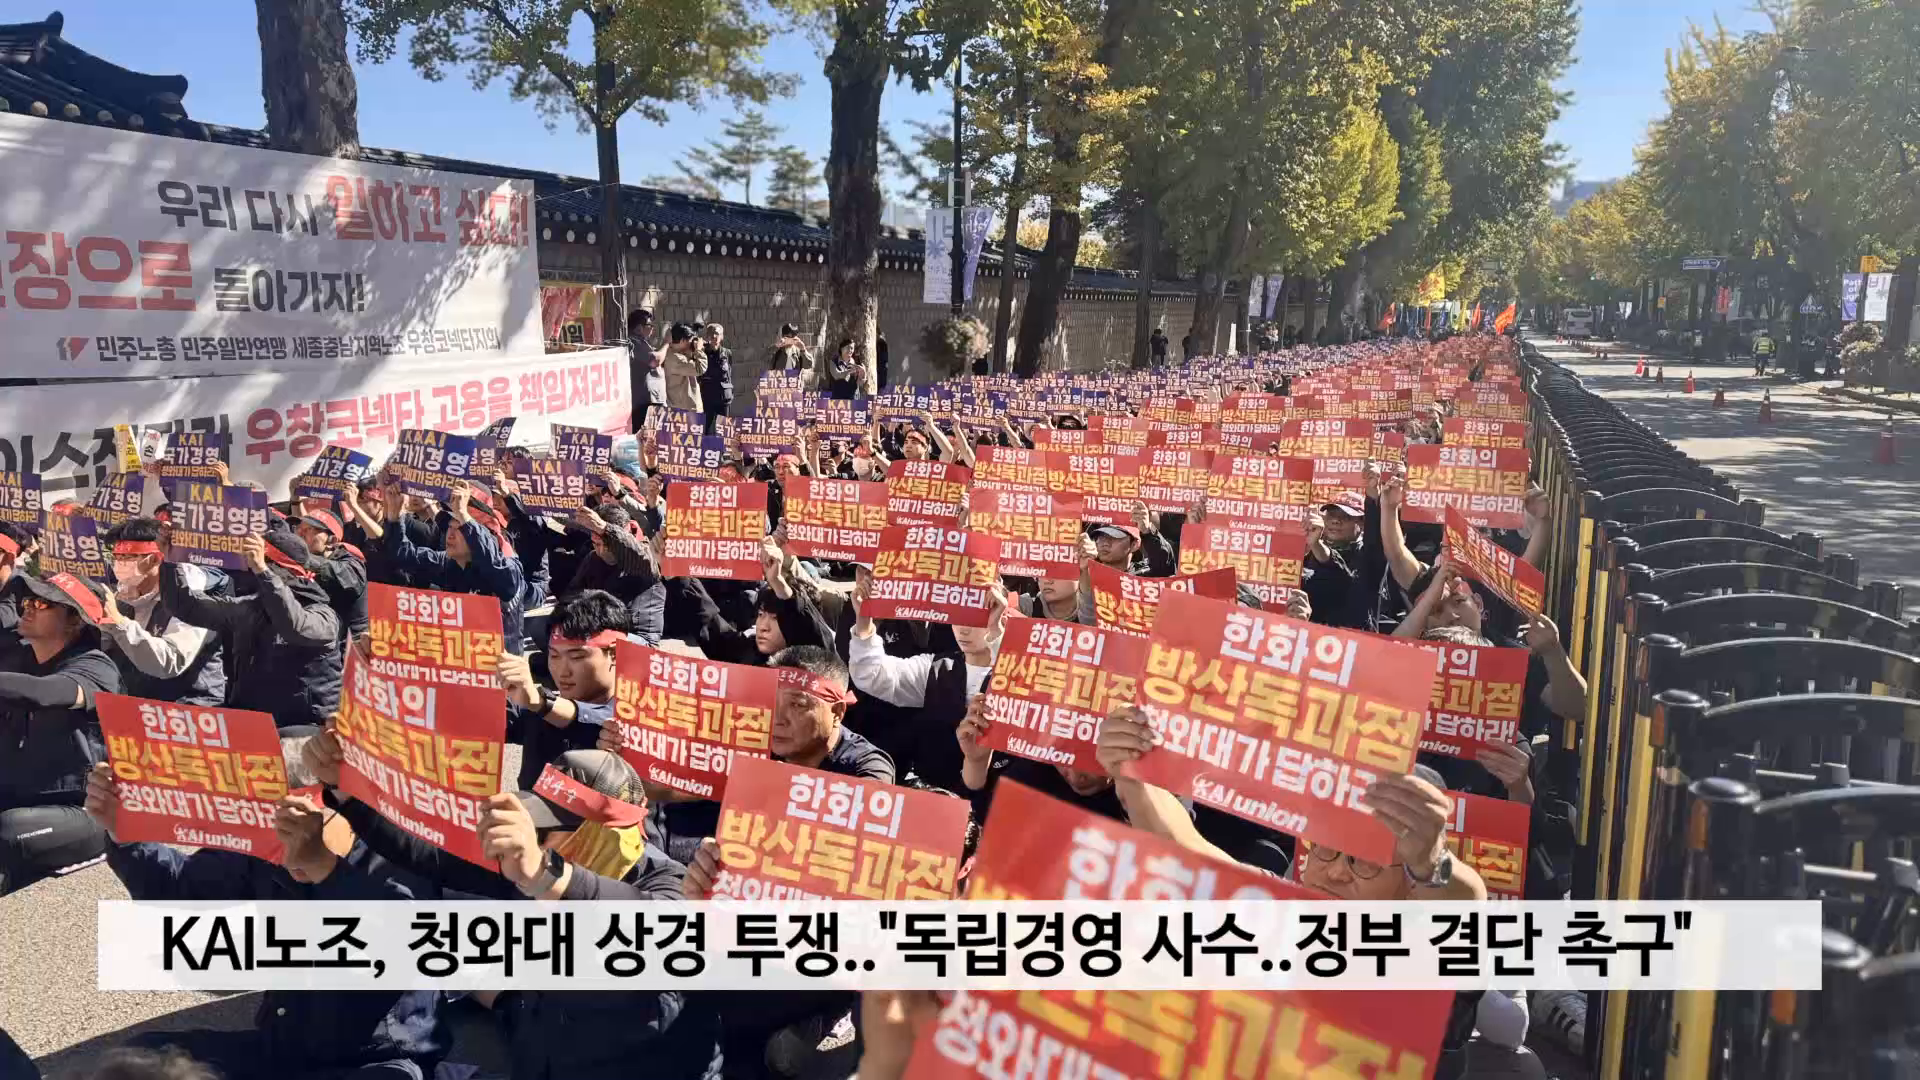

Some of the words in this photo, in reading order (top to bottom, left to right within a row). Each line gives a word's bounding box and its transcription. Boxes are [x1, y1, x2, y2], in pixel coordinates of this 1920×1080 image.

[157, 181, 237, 232] 우리
[245, 190, 318, 236] 다시
[327, 176, 446, 244] 일하고
[0, 231, 196, 311] 장으로
[214, 267, 364, 313] 돌아가자!
[96, 336, 176, 362] 민주노총
[180, 336, 288, 361] 민주일반연맹
[432, 377, 512, 433] 고용을
[519, 361, 619, 416] 책임져라!
[895, 384, 916, 394] KAI
[1370, 389, 1398, 402] 한화의
[1475, 393, 1510, 404] 한화의
[755, 407, 780, 418] KAI
[828, 399, 851, 410] KAI
[880, 394, 928, 409] 국가경영
[1149, 397, 1177, 409] 한화의
[1237, 398, 1269, 410] 한화의
[1357, 399, 1413, 413] 방산독과점
[741, 417, 796, 435] 국가경영
[816, 409, 866, 425] 국가경영
[1102, 416, 1132, 430] 한화의
[1220, 409, 1283, 424] 방산독과점
[1299, 420, 1347, 437] 한화의
[1463, 420, 1504, 437] 한화의
[179, 433, 205, 446] KAI
[572, 434, 595, 446] KAI
[671, 432, 703, 447] KAI
[1050, 430, 1085, 444] 한화의
[1165, 429, 1202, 445] 한화의
[1278, 437, 1371, 458] 방산독과점
[164, 447, 219, 467] 국가경영
[558, 443, 610, 465] 국가경영
[657, 443, 720, 468] 국가경영
[992, 448, 1031, 466] 한화의
[1069, 455, 1114, 475] 한화의
[1152, 449, 1192, 467] 한화의
[1439, 446, 1498, 469] 한화의
[532, 460, 561, 474] KAI
[904, 461, 948, 481] 한화의
[974, 460, 1048, 487] 방산독과점
[1231, 457, 1285, 479] 한화의
[516, 474, 584, 497] 국가경영
[809, 480, 860, 504] 한화의
[1048, 468, 1140, 498] 방산독과점
[1207, 474, 1312, 506] 방산독과점
[1407, 464, 1527, 497] 방산독과점
[191, 483, 223, 504] KAI
[690, 485, 737, 508] 한화의
[998, 493, 1053, 516] 한화의
[1405, 490, 1468, 511] 청와대가
[786, 496, 888, 530] 방산독과점
[888, 498, 921, 515] 와대가
[1205, 498, 1259, 519] 청와대가
[667, 507, 765, 540] 방산독과점
[786, 523, 838, 546] 청와대가
[970, 510, 1080, 546] 방산독과점
[664, 539, 716, 561] 청와대가
[904, 526, 968, 554] 한화의
[1210, 528, 1273, 555] 한화의
[871, 549, 1000, 588] 방산독과점
[869, 579, 930, 602] 청와대가
[396, 590, 463, 627] 한화의
[370, 615, 503, 671] 방산독과점
[1026, 622, 1106, 666] 한화의
[1219, 610, 1359, 689] 한화의
[649, 652, 729, 699] 한화의
[990, 652, 1137, 714] 방산독과점
[354, 660, 437, 731] 한화의
[614, 675, 773, 750] 방산독과점
[982, 693, 1050, 733] 청와대가
[1142, 641, 1423, 776] 방산독과점
[138, 702, 231, 749] 한화의
[1435, 712, 1516, 745] 답하라!
[335, 688, 501, 797] 방산독과점
[617, 720, 688, 767] 청와대가
[1006, 732, 1028, 755] KAI
[1026, 744, 1076, 767] union
[1138, 703, 1272, 781] 청와대가
[107, 733, 289, 801] 방산독과점
[337, 734, 411, 806] 청와대가
[648, 763, 672, 786] KAI
[671, 776, 714, 798] union
[116, 781, 216, 822] 청와대가
[786, 772, 905, 840] 한화의
[1190, 769, 1236, 811] KAI
[1233, 790, 1309, 834] union
[376, 794, 402, 826] KAI
[400, 814, 445, 847] union
[173, 823, 204, 844] KAI
[203, 832, 253, 853] union
[718, 808, 958, 900] 방산독과점
